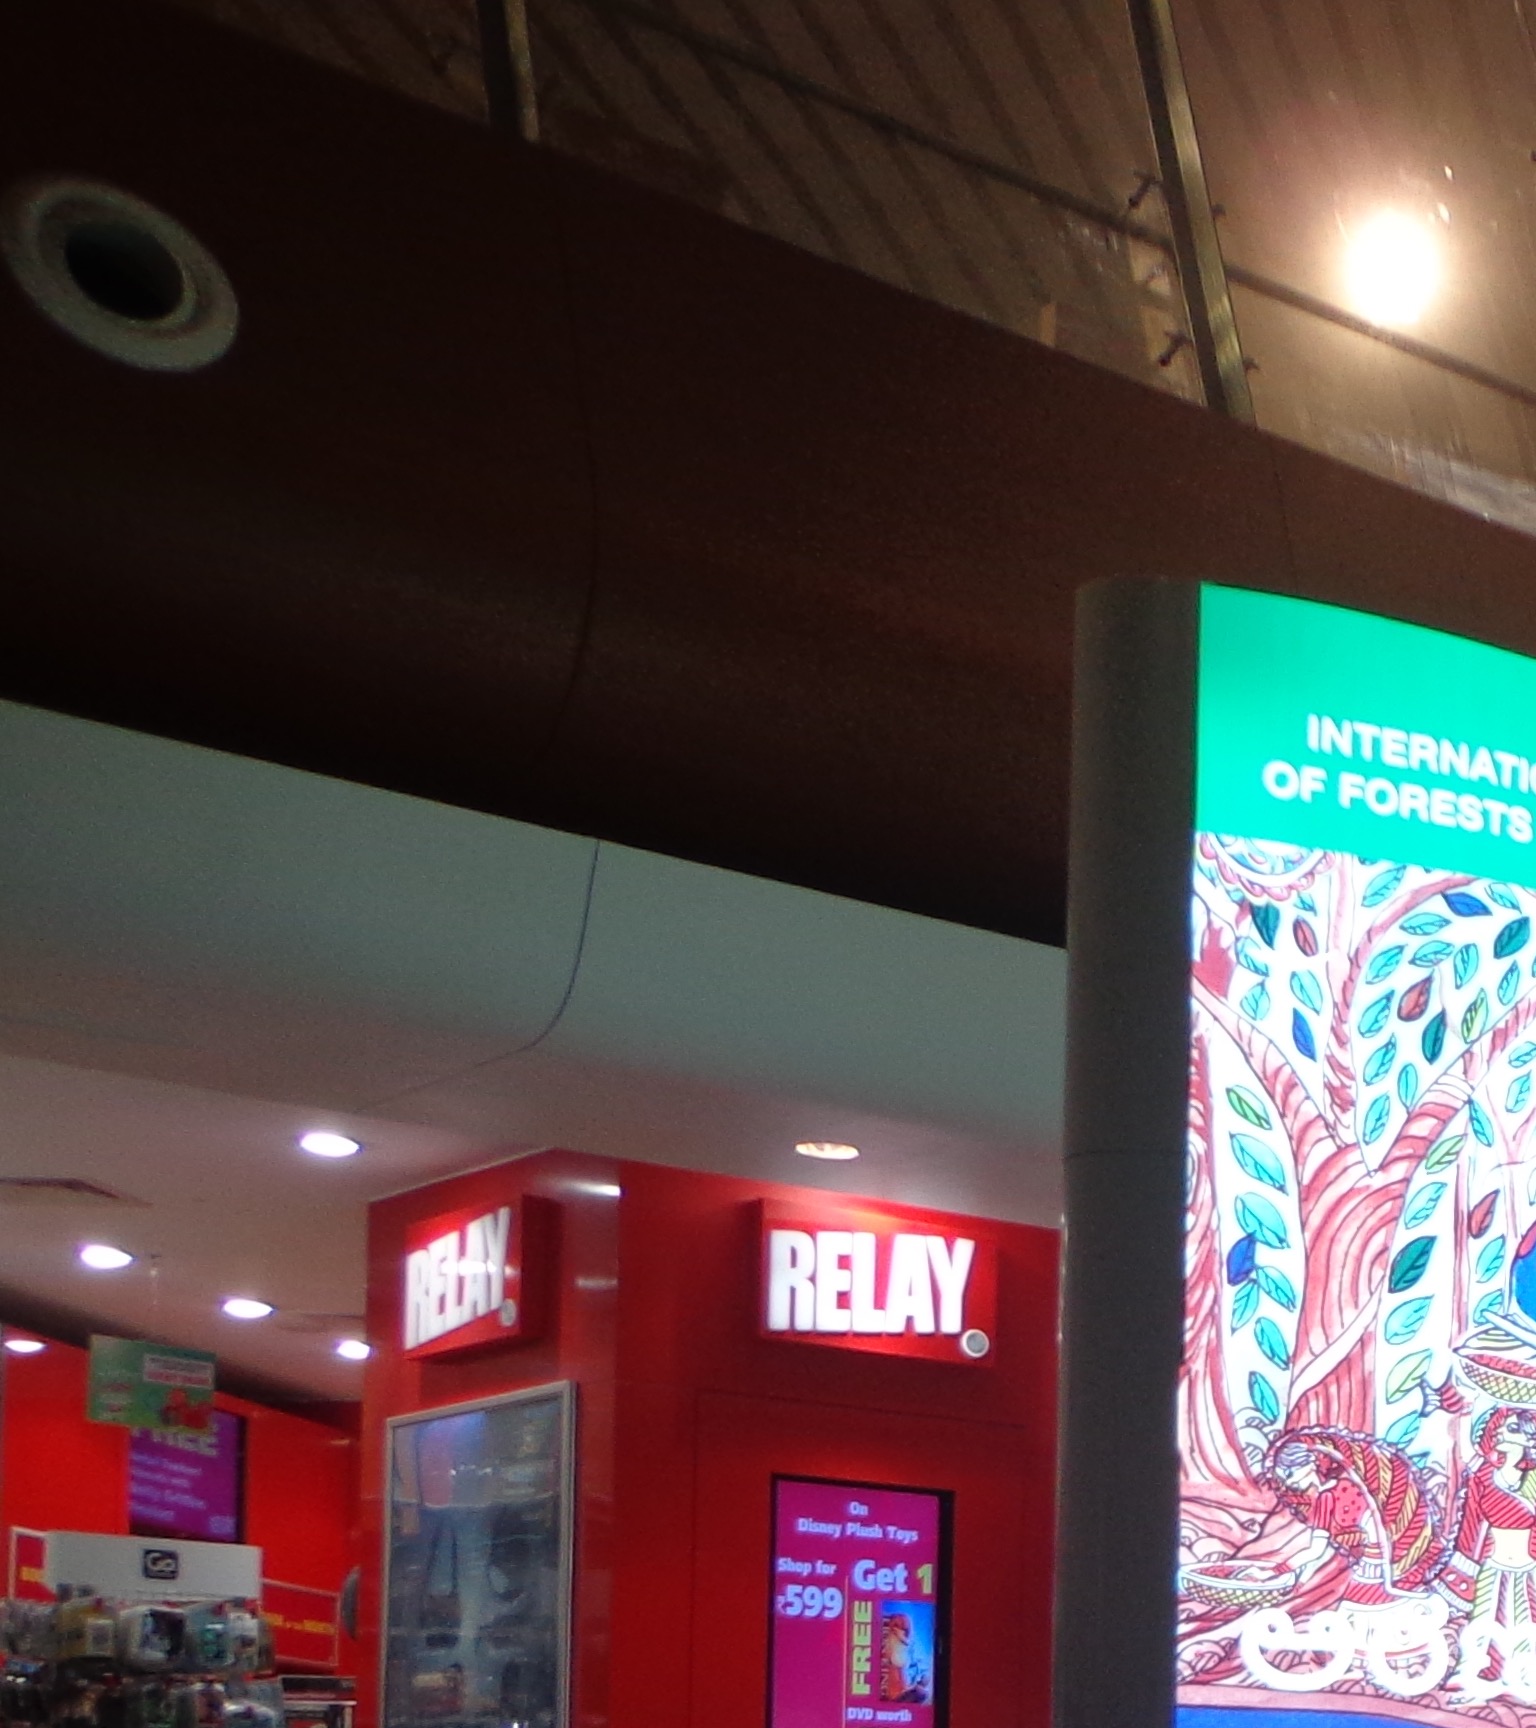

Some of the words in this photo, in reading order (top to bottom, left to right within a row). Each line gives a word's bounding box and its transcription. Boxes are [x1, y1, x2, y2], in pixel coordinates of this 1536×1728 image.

[1261, 758, 1328, 804] OF
[1337, 770, 1534, 844] FORESTS
[404, 1205, 512, 1351] RELAY
[767, 1228, 976, 1335] RELAY
[849, 1500, 869, 1516] On
[797, 1517, 843, 1538] Disney
[846, 1521, 884, 1539] Plush
[886, 1525, 919, 1544] Toys
[777, 1557, 812, 1576] Shop
[815, 1559, 837, 1574] for
[852, 1559, 908, 1593] Get
[916, 1563, 934, 1595] 1
[851, 1600, 873, 1695] FREE
[846, 1706, 874, 1720] DVD
[876, 1708, 912, 1722] worth
